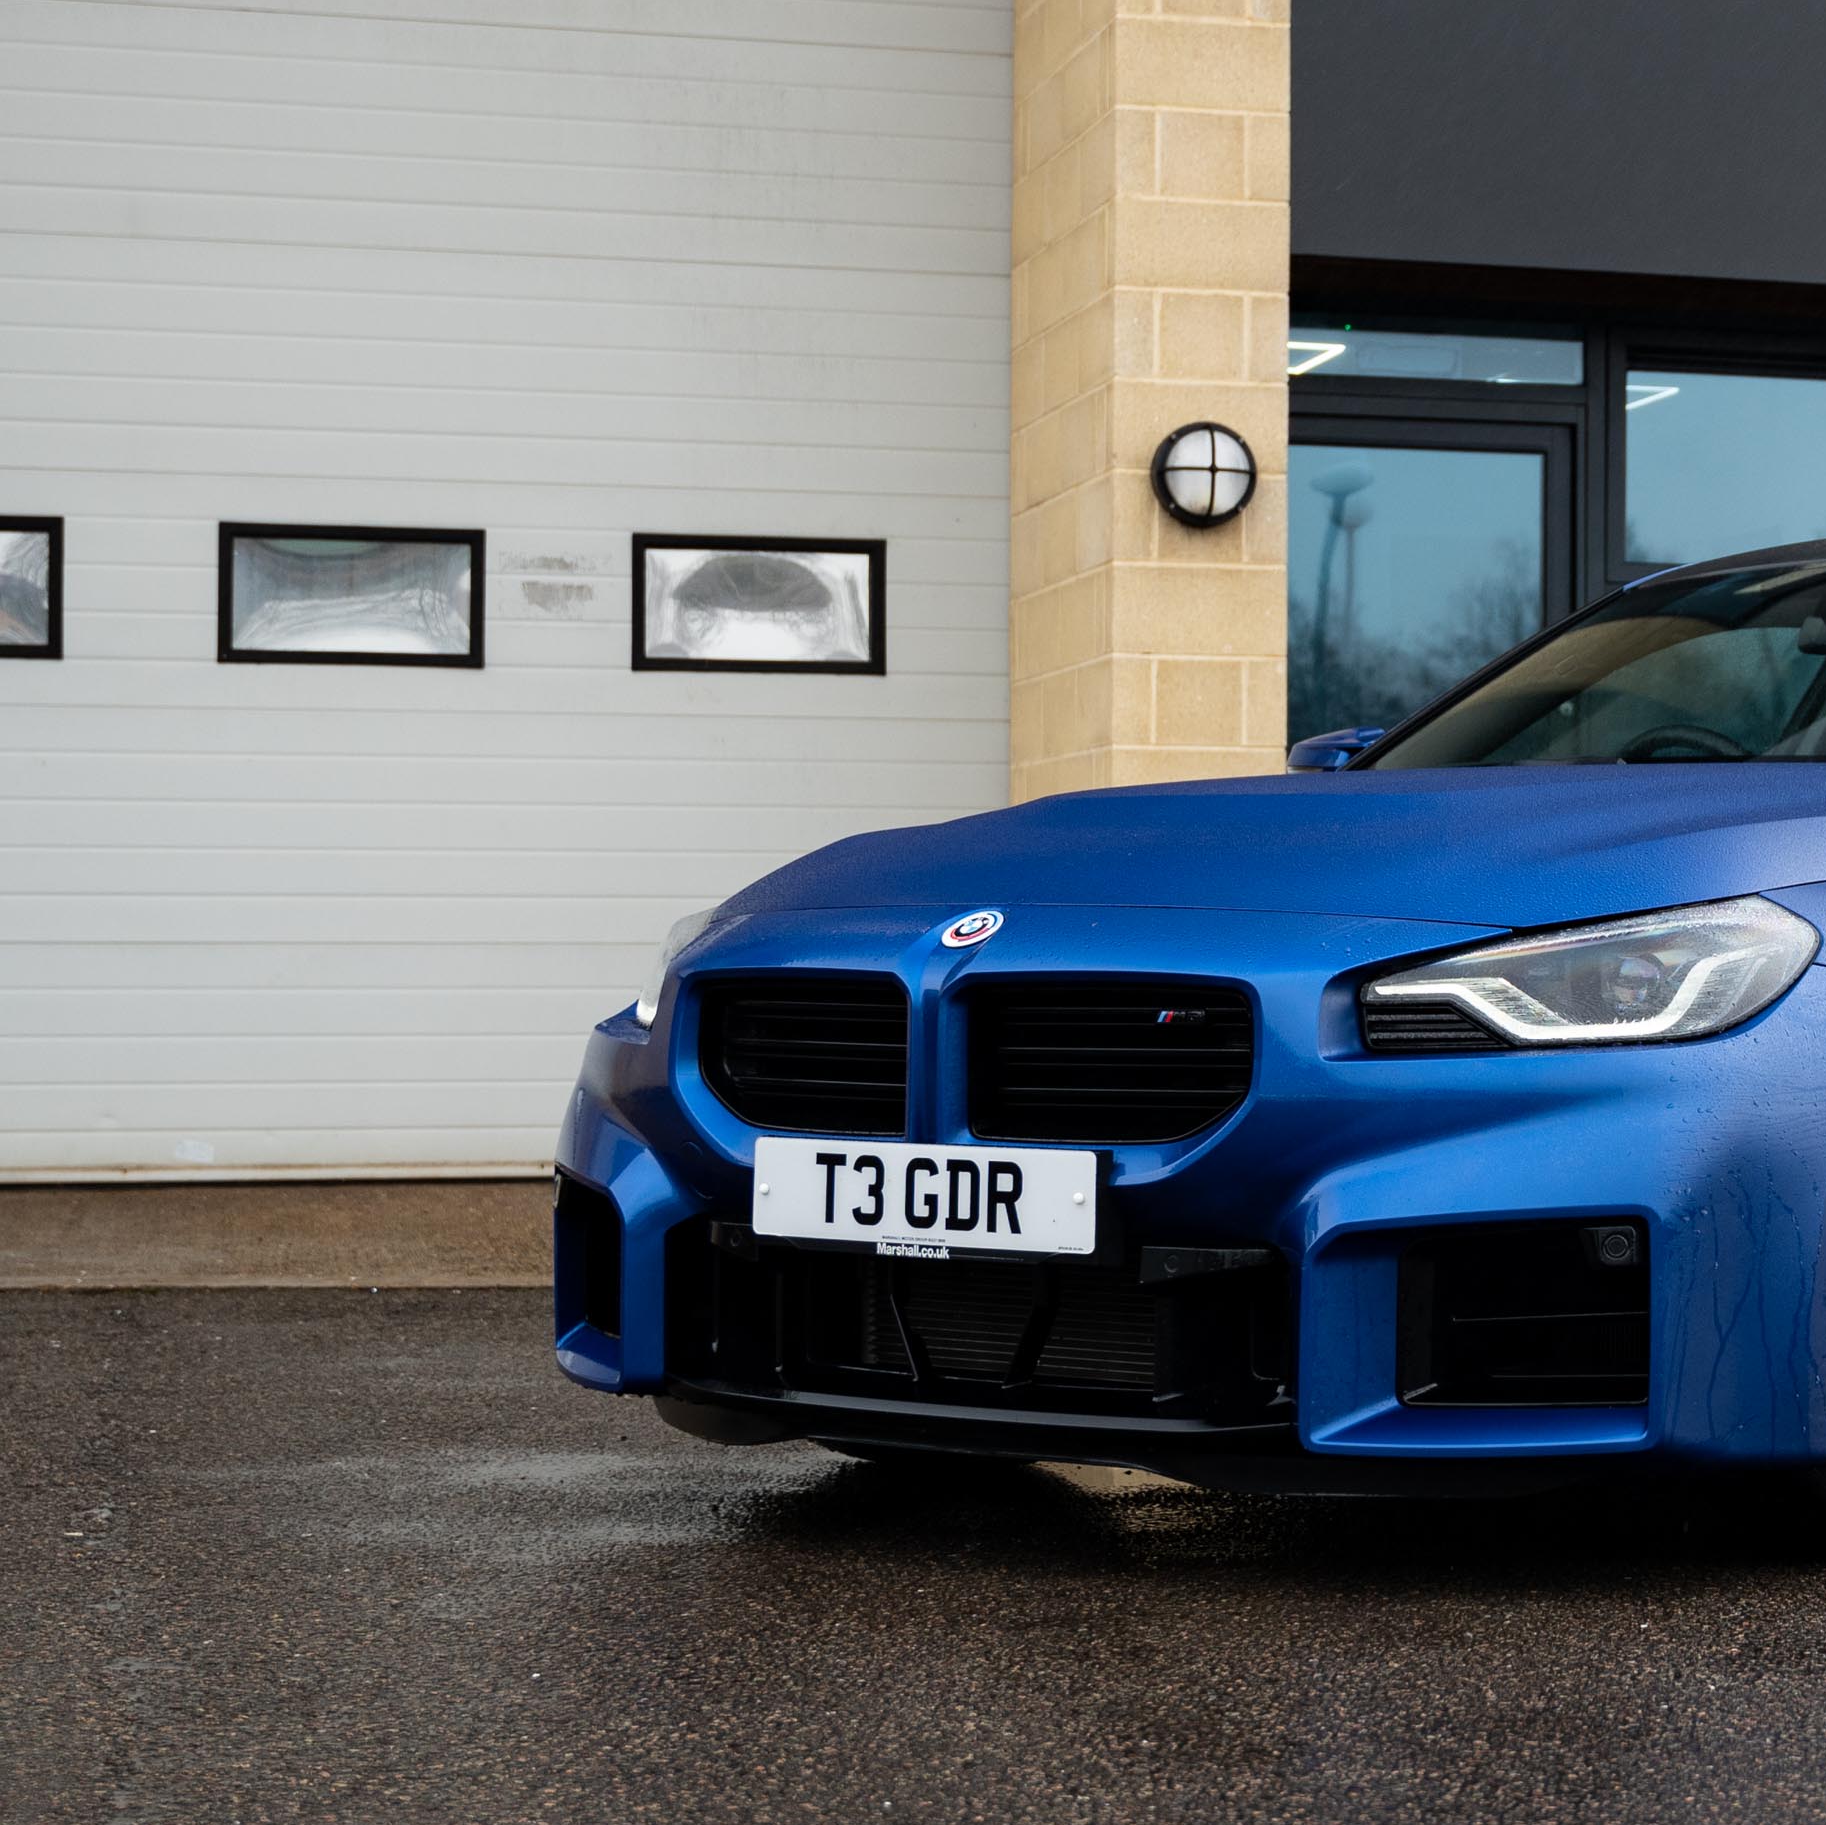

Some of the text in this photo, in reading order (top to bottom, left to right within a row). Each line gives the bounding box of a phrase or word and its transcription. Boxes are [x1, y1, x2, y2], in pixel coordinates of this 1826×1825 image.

[815, 1152, 1023, 1234] T3 GDR
[876, 1242, 950, 1260] Marshall.co.uk
